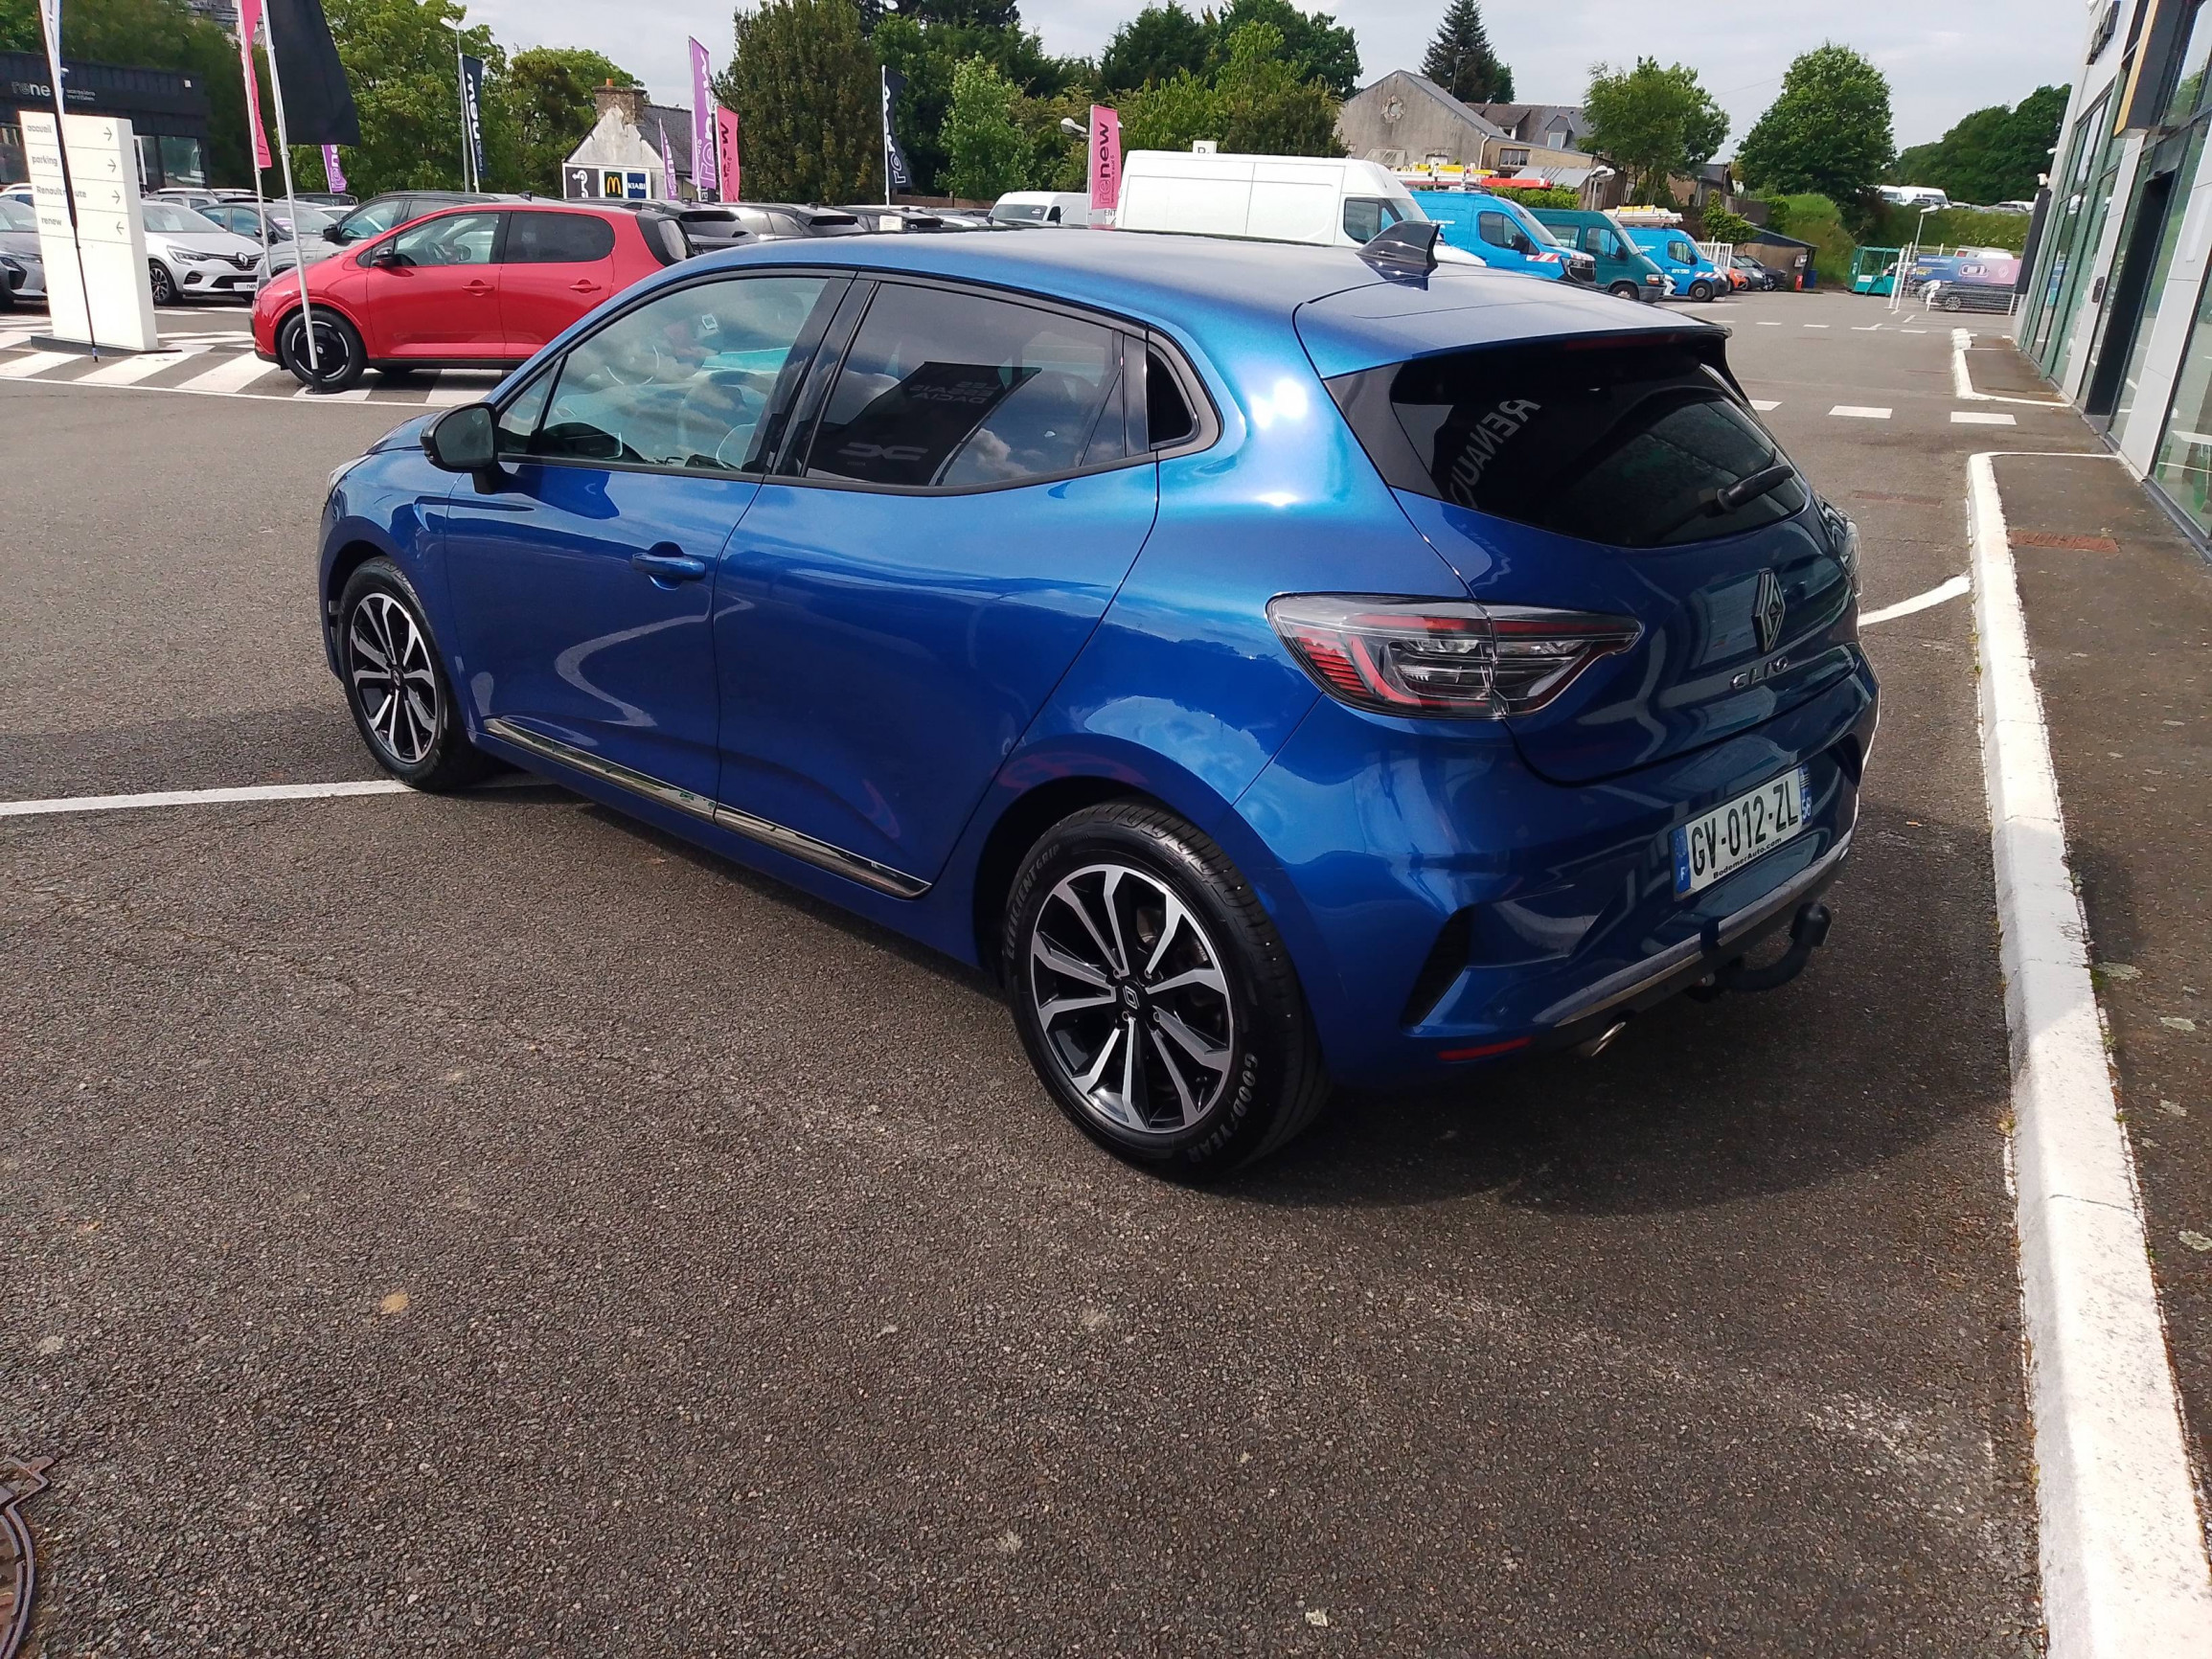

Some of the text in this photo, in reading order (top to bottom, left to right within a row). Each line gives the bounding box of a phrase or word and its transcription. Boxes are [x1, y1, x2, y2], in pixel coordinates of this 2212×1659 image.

[27, 125, 52, 133] accueil
[32, 155, 58, 167] parking
[1099, 122, 1109, 204] renew
[36, 186, 63, 196] Renault
[41, 217, 62, 226] renew
[1730, 655, 1790, 691] CLIO
[1801, 796, 1813, 820] 56
[1691, 780, 1799, 876] GV-012-ZL
[1713, 837, 1783, 880] BodemerAuto.com
[1679, 866, 1687, 881] F
